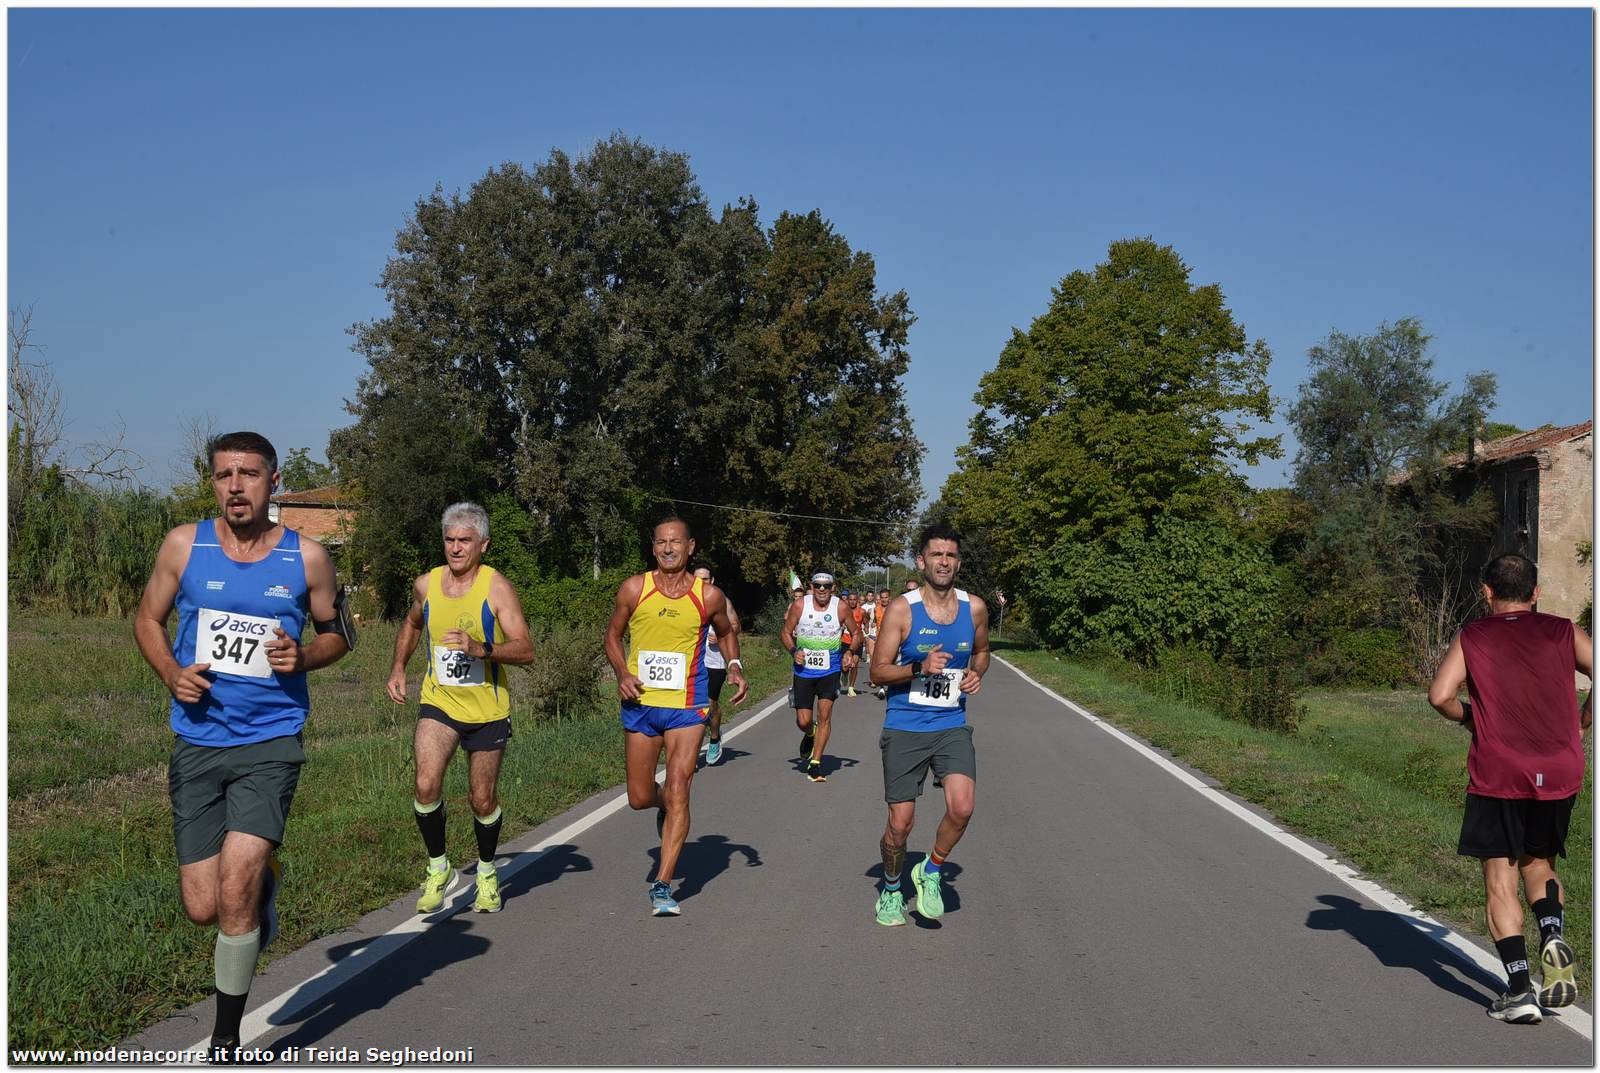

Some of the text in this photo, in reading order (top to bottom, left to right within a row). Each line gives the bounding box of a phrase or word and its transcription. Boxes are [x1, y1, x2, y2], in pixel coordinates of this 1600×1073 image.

[229, 620, 267, 635] asics
[211, 633, 259, 665] 347
[807, 656, 824, 667] 482
[446, 662, 472, 679] 507
[649, 665, 673, 681] 528
[924, 680, 951, 700] 184
[1509, 960, 1526, 972] FS
